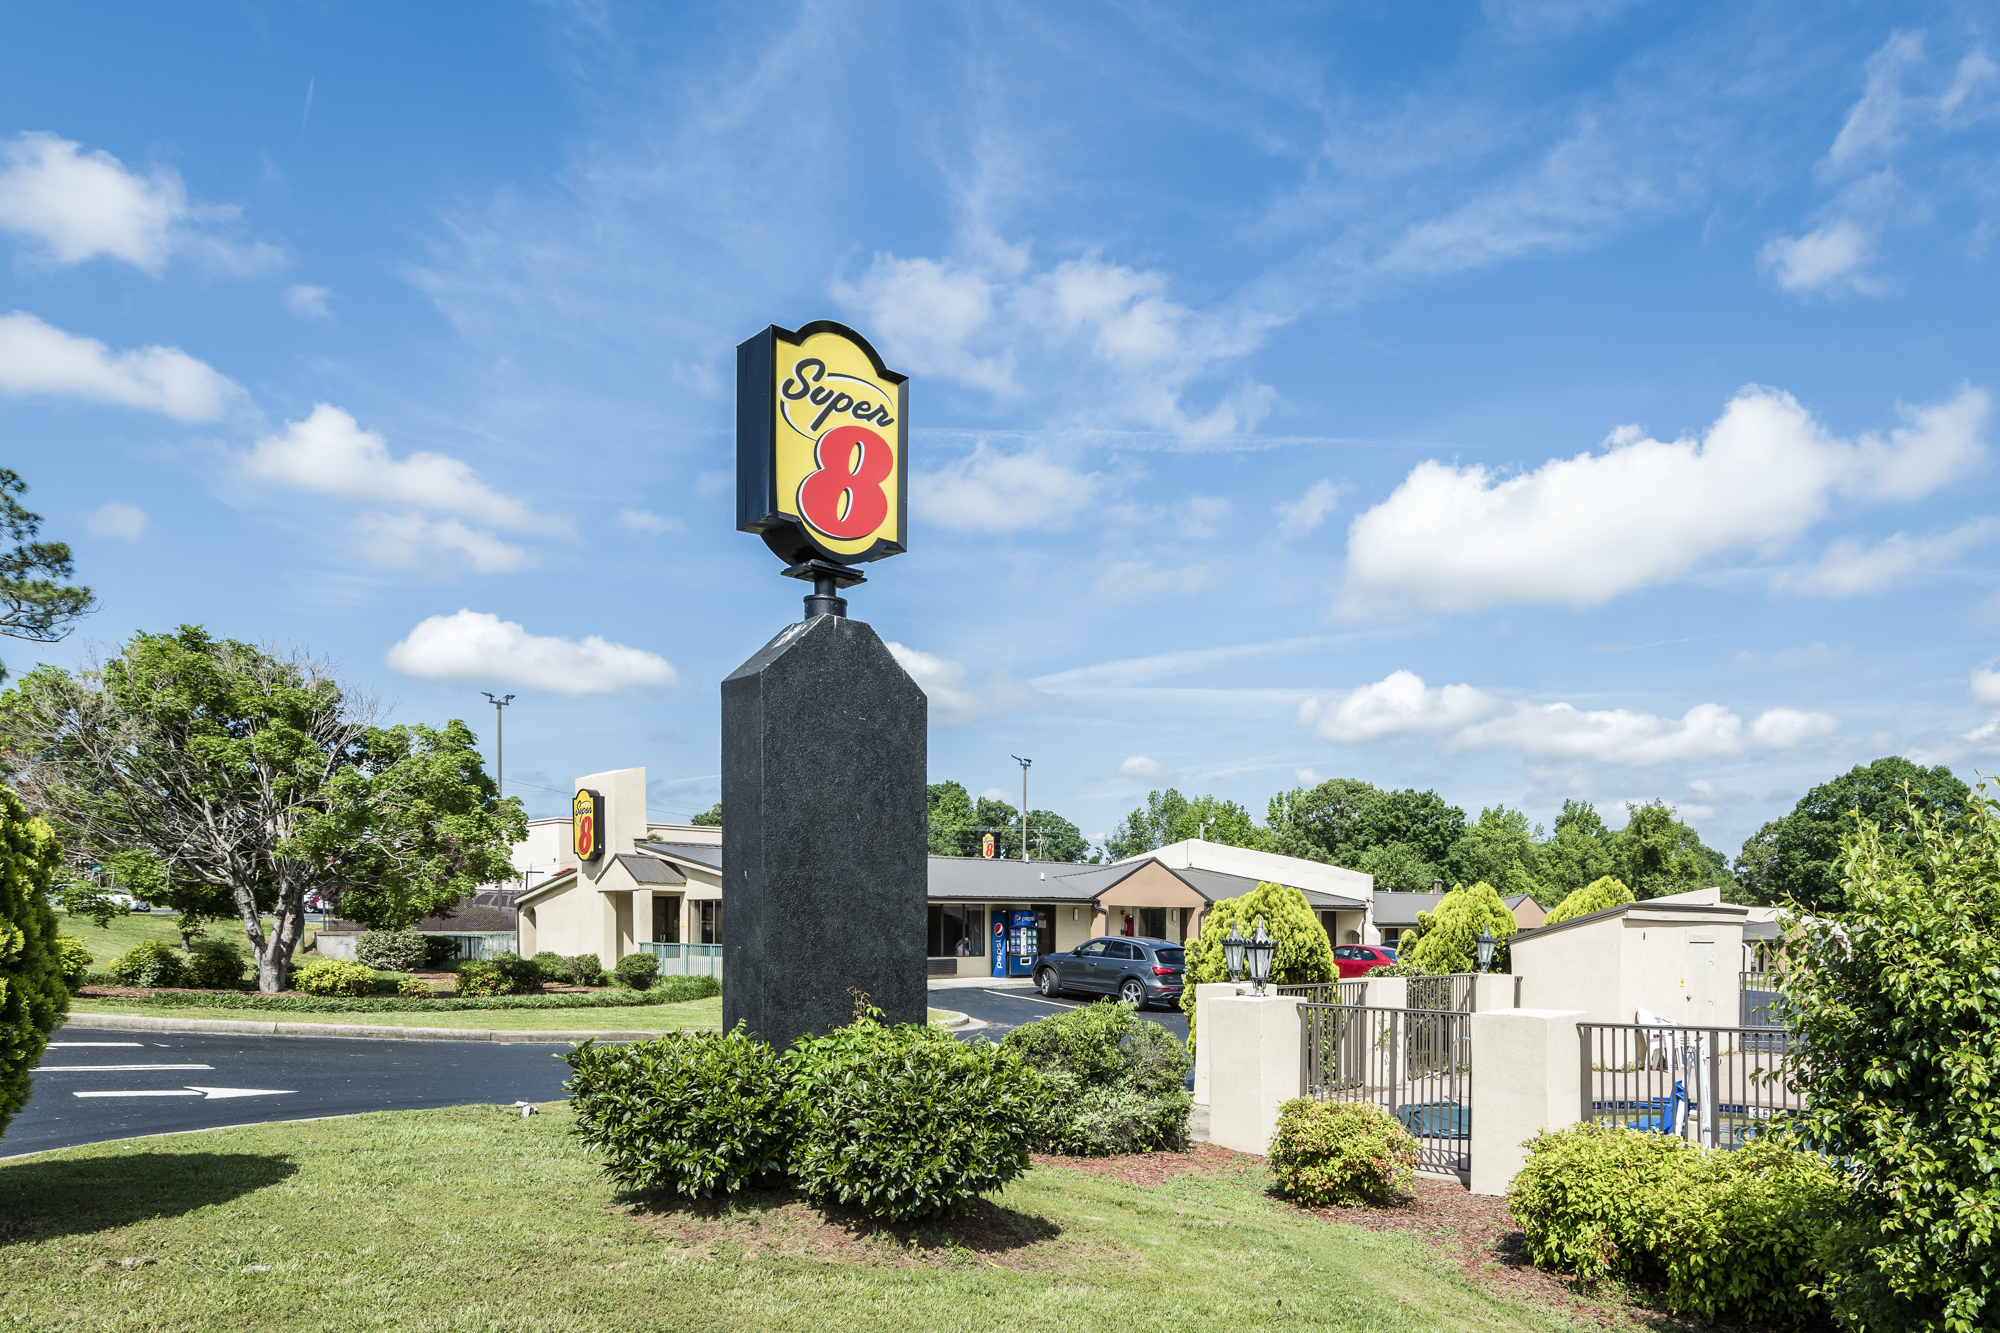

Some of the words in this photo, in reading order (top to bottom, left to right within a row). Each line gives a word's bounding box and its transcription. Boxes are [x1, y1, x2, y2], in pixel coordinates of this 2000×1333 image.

[780, 358, 895, 432] Super
[797, 425, 893, 541] 8
[575, 801, 592, 823] Super
[578, 816, 592, 854] 8
[985, 843, 993, 857] 8
[995, 939, 1003, 969] pepsi
